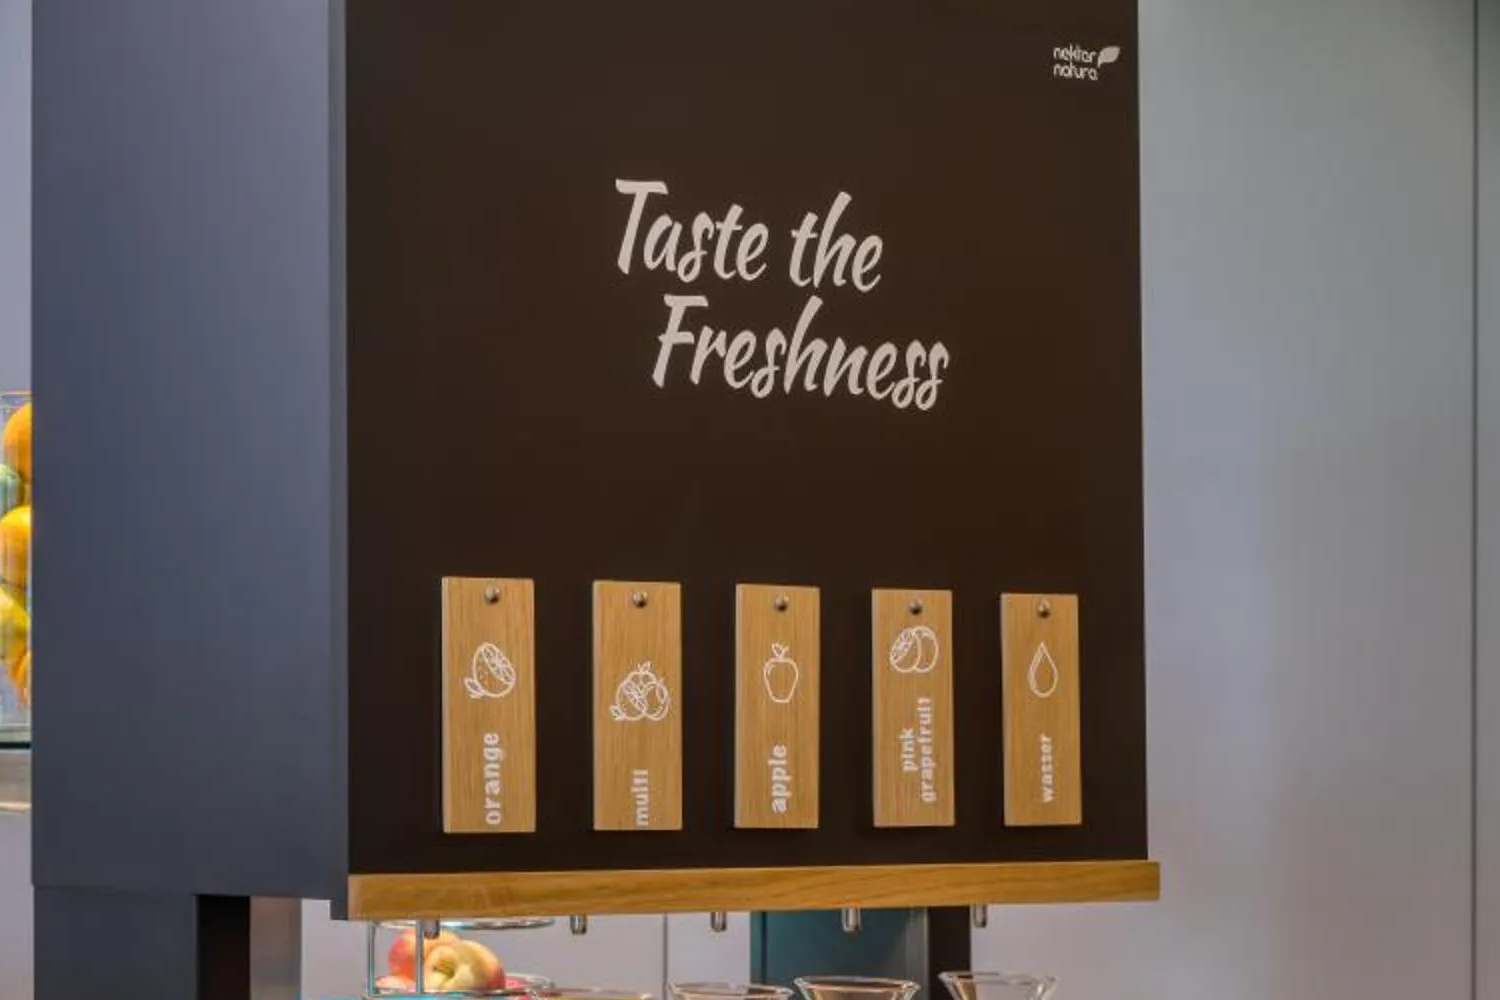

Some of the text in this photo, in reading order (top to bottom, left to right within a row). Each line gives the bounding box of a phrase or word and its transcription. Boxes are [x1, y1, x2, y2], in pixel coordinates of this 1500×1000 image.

[1053, 44, 1097, 63] nektar
[1053, 61, 1099, 81] natura
[615, 178, 883, 292] Taste the
[652, 294, 950, 411] Freshness
[483, 731, 504, 826] orange
[768, 744, 791, 814] apple
[899, 726, 917, 772] pink
[916, 697, 935, 803] grapefruit
[1040, 734, 1054, 803] wasser
[631, 768, 649, 827] multi
